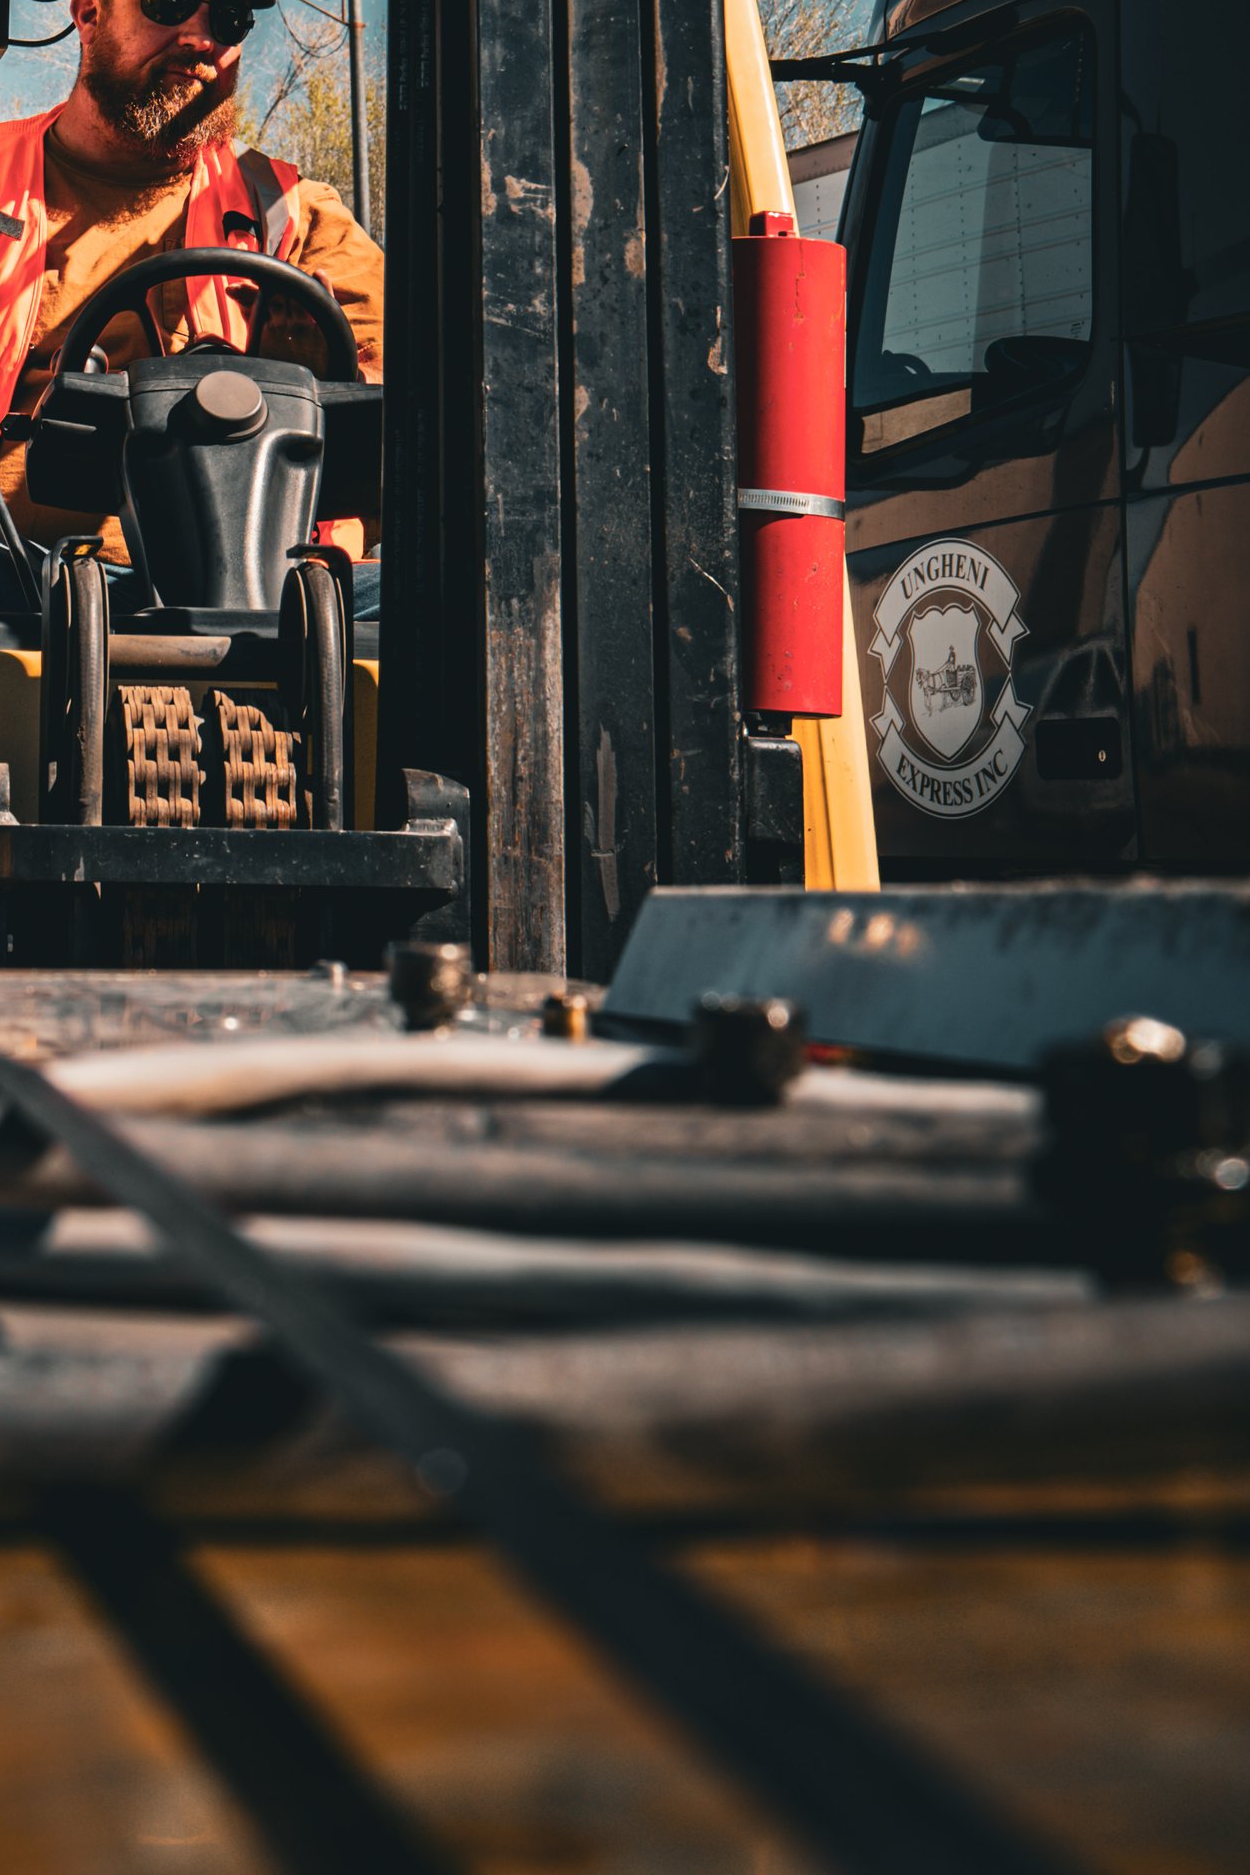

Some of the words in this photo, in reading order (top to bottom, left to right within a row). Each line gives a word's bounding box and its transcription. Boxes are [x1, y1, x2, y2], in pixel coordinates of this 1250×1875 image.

[901, 553, 989, 599] UNGHENI
[896, 753, 974, 806] EXPRESS
[977, 750, 1008, 797] INC
